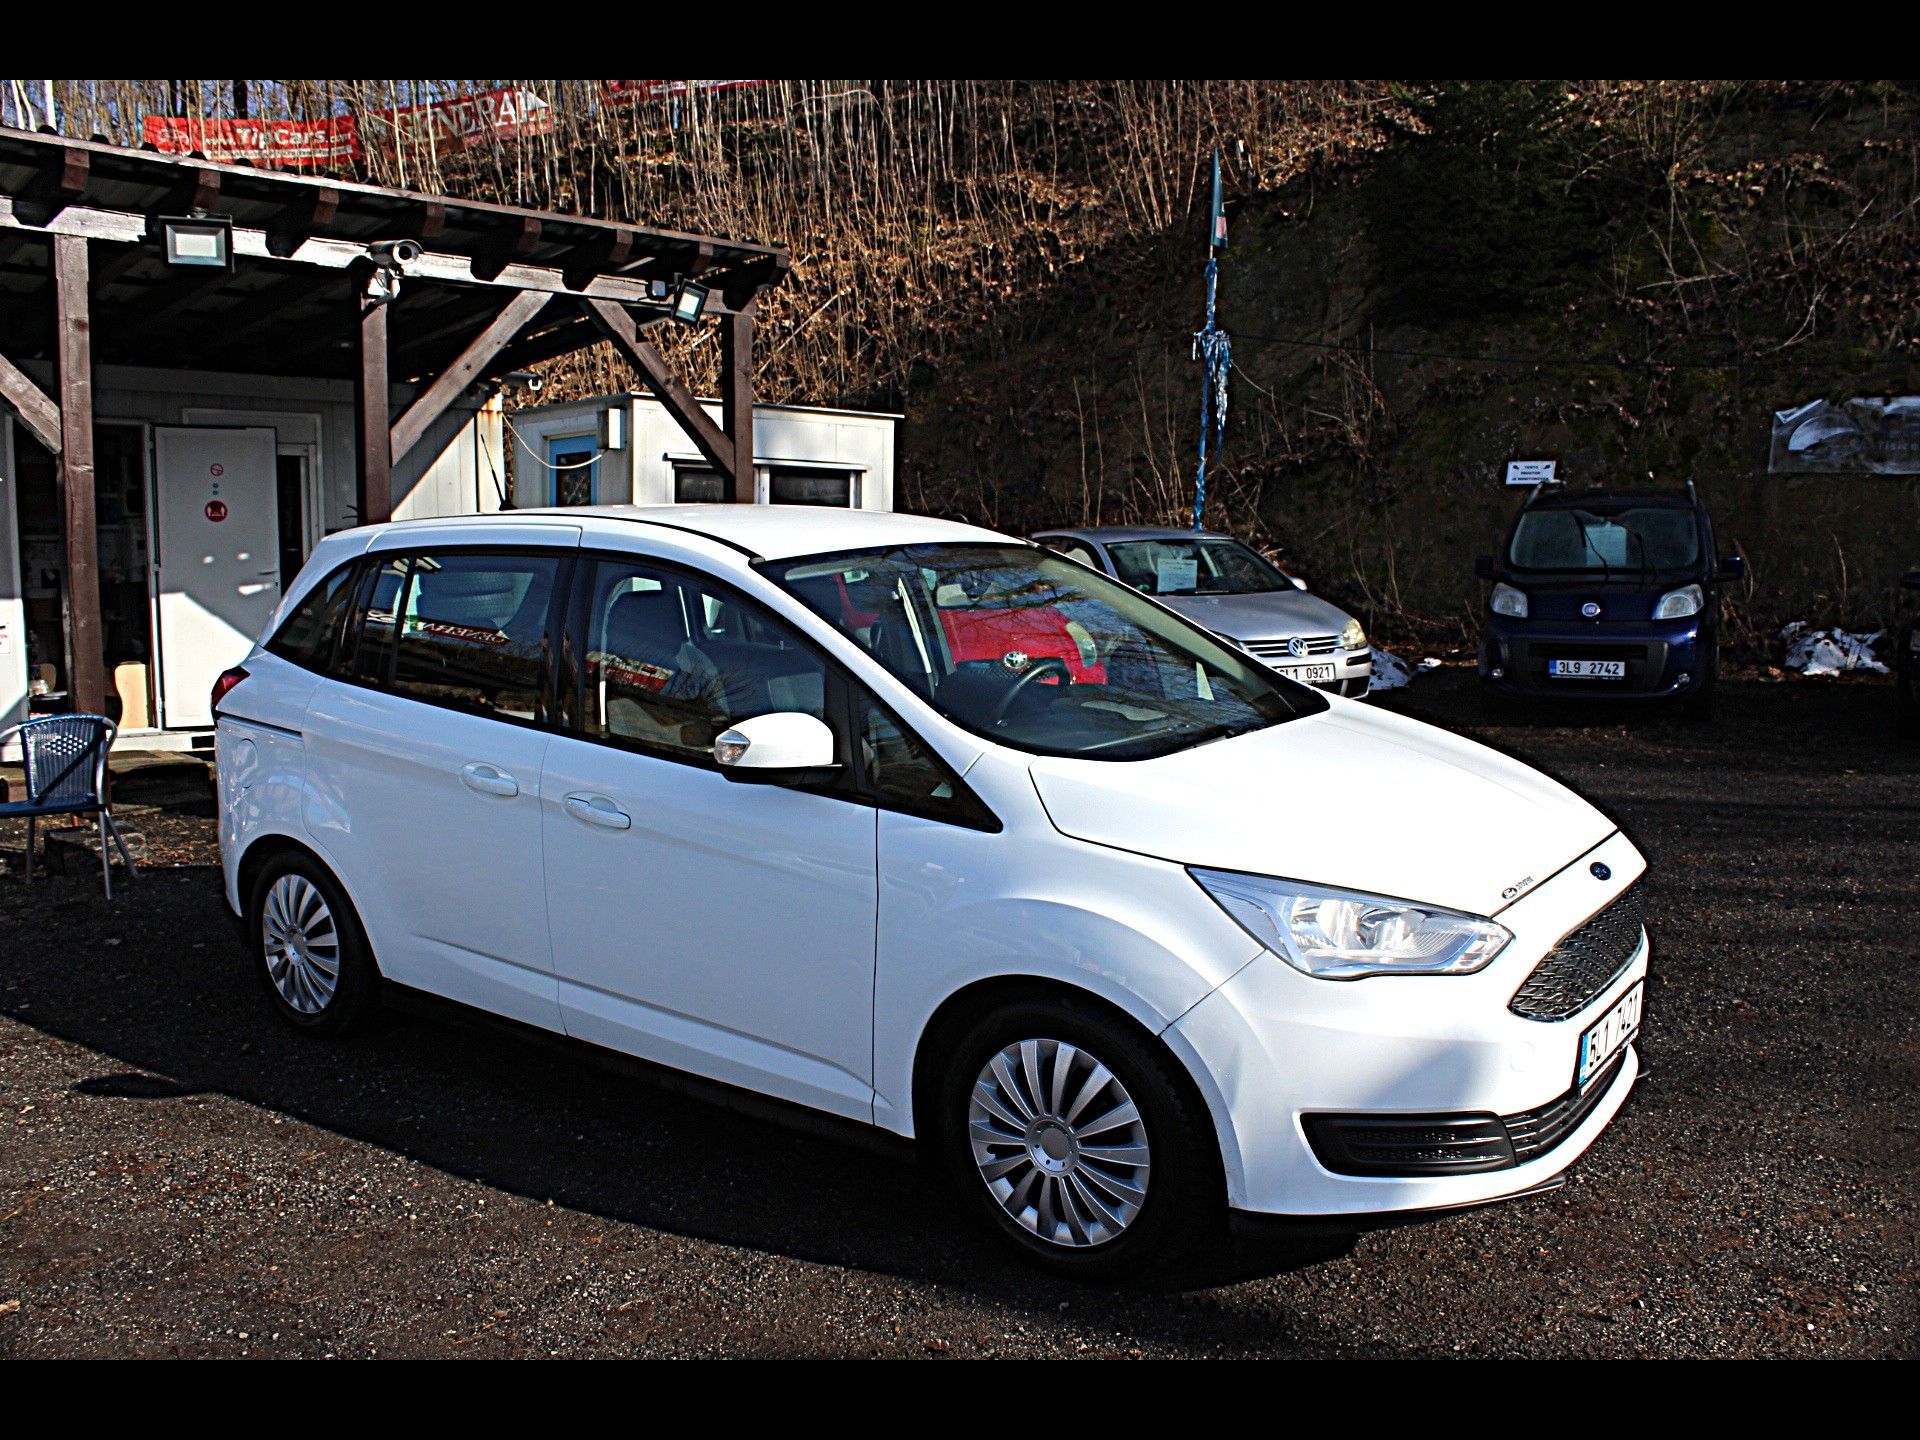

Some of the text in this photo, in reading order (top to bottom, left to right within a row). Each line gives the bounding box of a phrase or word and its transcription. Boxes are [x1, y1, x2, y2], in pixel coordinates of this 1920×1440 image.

[1306, 666, 1330, 679] 0921
[1559, 661, 1620, 675] 3L9 2742
[1588, 991, 1638, 1068] 5L1 7421
